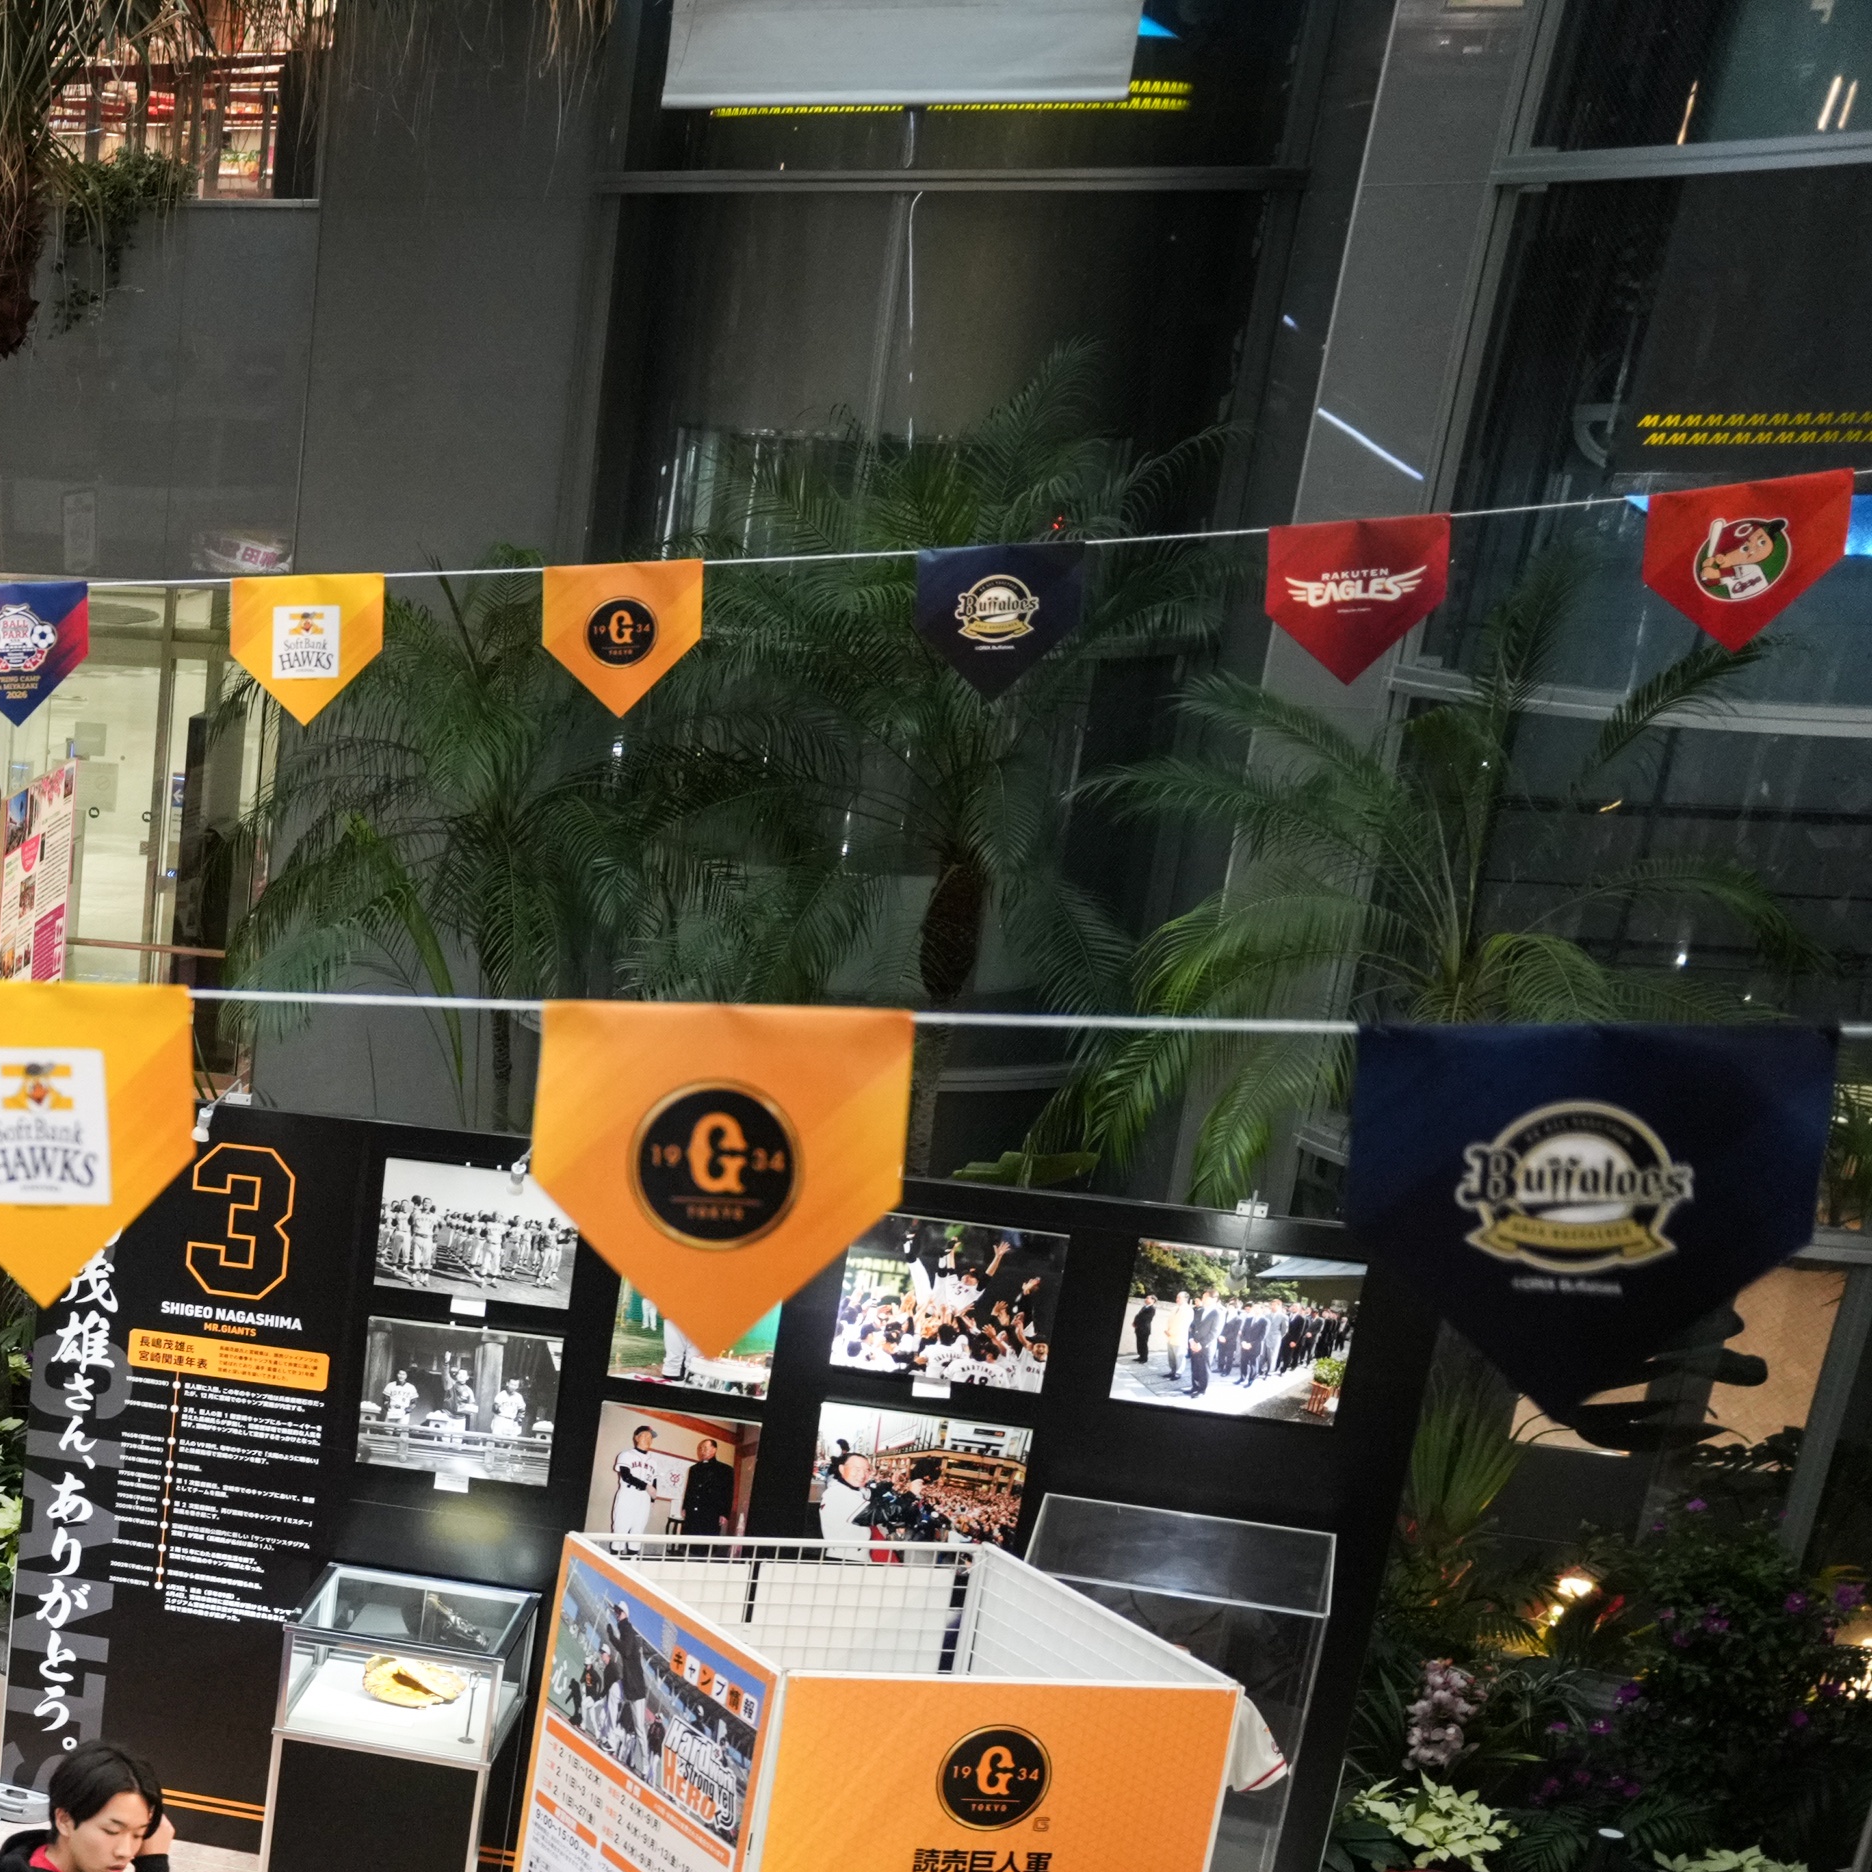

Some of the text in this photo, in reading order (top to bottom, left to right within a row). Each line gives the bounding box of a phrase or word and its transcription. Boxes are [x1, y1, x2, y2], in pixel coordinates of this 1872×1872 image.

[1321, 566, 1390, 581] RAKUTEN
[956, 592, 1038, 619] Buffaloes
[2, 620, 29, 630] BALL
[2, 629, 31, 640] PARK
[593, 609, 651, 645] 19 G 34
[283, 637, 328, 652] SoftBank
[278, 651, 334, 671] HAWKS
[6, 690, 28, 700] 2026
[650, 1109, 787, 1195] 19 G 34
[1465, 1138, 1692, 1206] Buffaloes
[185, 1142, 297, 1302] 3
[160, 1300, 303, 1332] SHIGEO NAGASHIMA
[203, 1322, 257, 1338] MR.GIANTS
[139, 1335, 195, 1354] 長嶋茂雄氏
[138, 1350, 208, 1370] 宮崎関連年表
[32, 1230, 124, 1756] 茂雄さん、ありがとう。
[952, 1745, 1040, 1796] 19 G 34
[971, 1802, 1008, 1812] TOKYO
